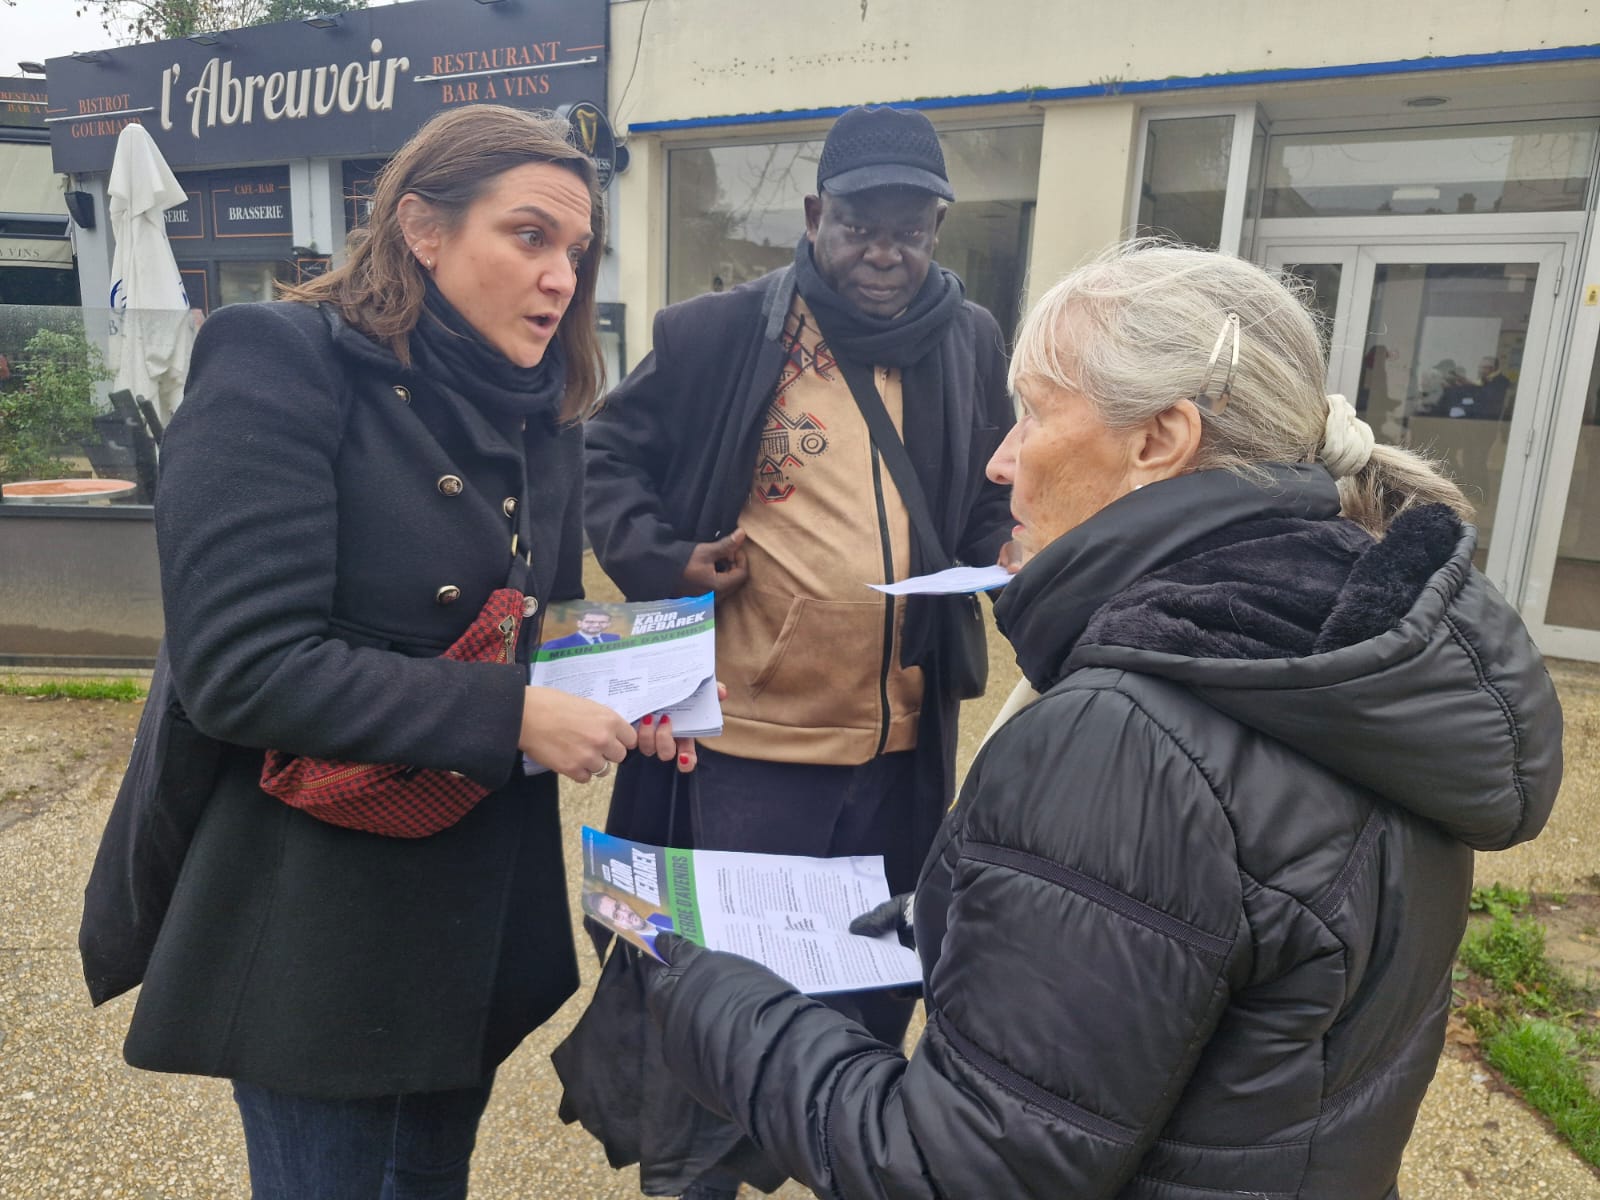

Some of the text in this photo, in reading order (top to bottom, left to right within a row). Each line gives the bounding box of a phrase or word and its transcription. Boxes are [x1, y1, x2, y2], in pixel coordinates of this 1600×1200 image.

[432, 41, 561, 75] RESTAURANT
[160, 38, 410, 139] l'Abreuvoir
[442, 74, 551, 104] BAR À VINS
[79, 93, 130, 115] BISTROT
[229, 205, 284, 220] BRASSERIE
[7, 247, 40, 258] VINS
[630, 611, 706, 636] MEBAREK
[634, 611, 678, 626] KADIR
[549, 645, 594, 660] MELUN
